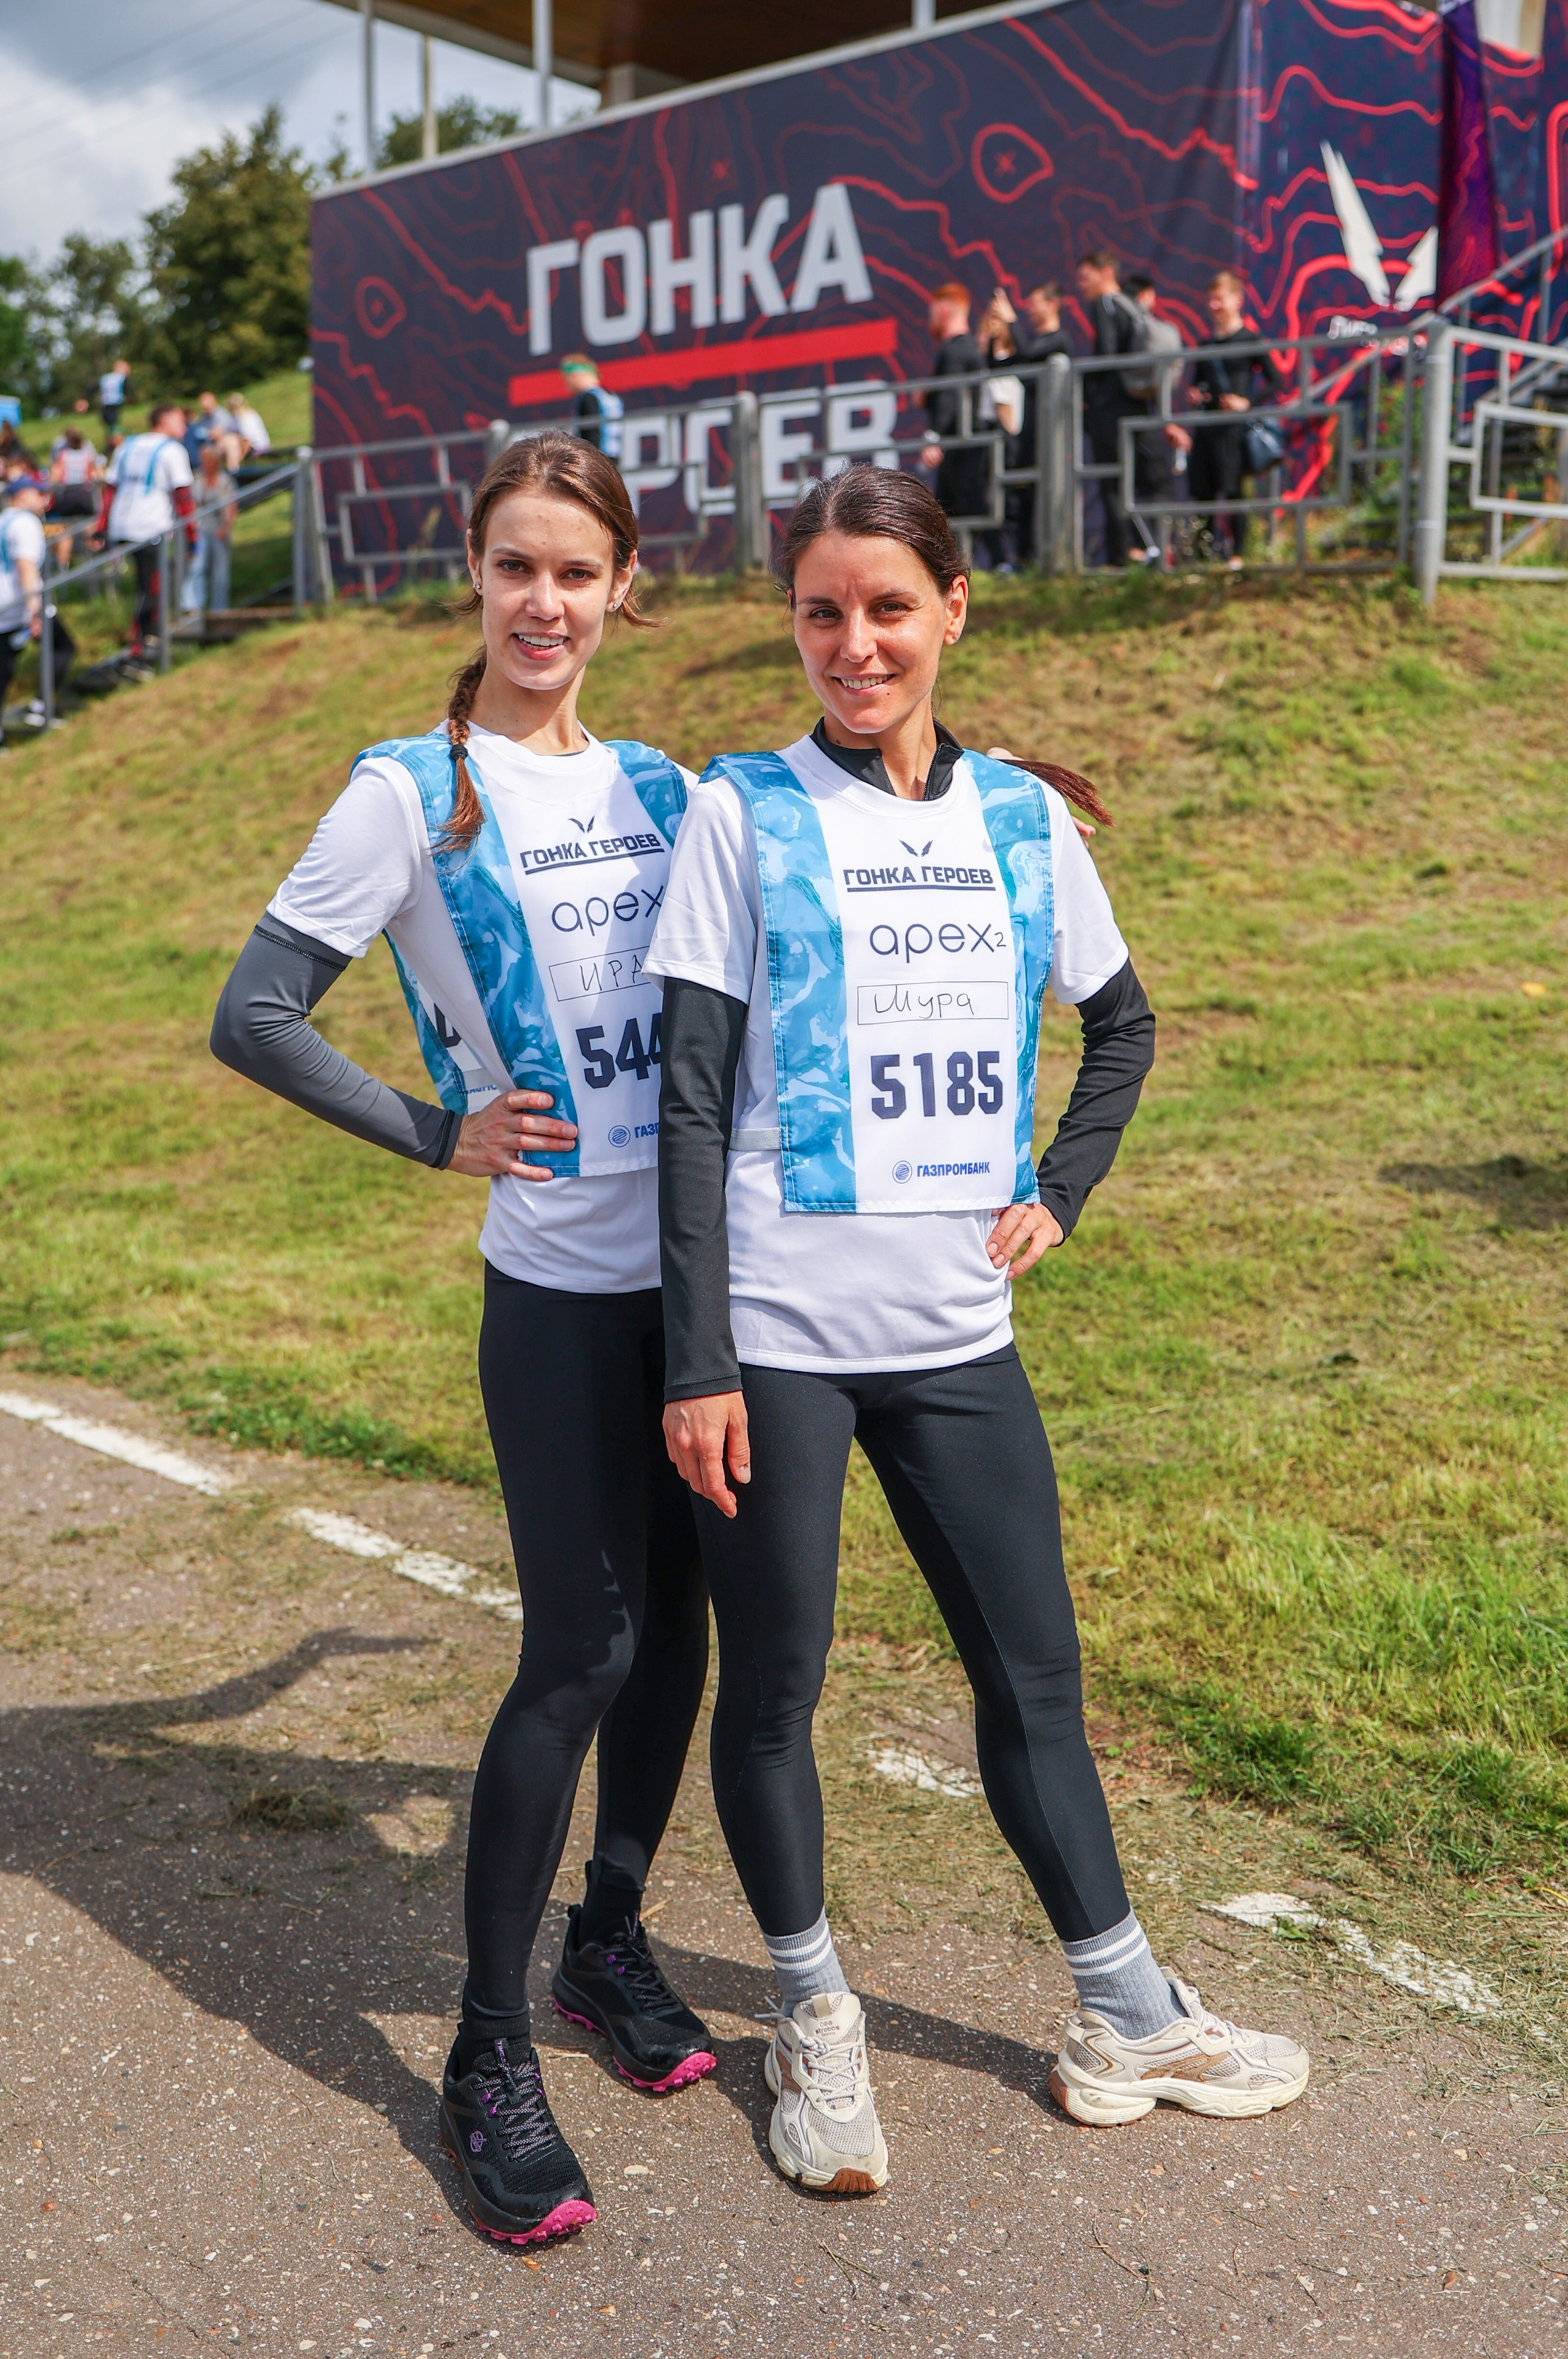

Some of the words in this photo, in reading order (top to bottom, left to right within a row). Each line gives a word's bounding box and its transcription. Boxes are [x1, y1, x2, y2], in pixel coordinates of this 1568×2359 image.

[526, 183, 874, 356] ГОНКА
[520, 842, 588, 868] ГОНКА
[588, 833, 661, 856] ГЕРОЕВ
[843, 866, 916, 885] ГОНКА
[921, 865, 994, 884] ГЕРОЕВ
[551, 885, 664, 937] apex
[579, 954, 644, 992] ИРА
[871, 1050, 1003, 1120] 5185
[916, 1161, 991, 1177] ГАЗПРОМБАНК
